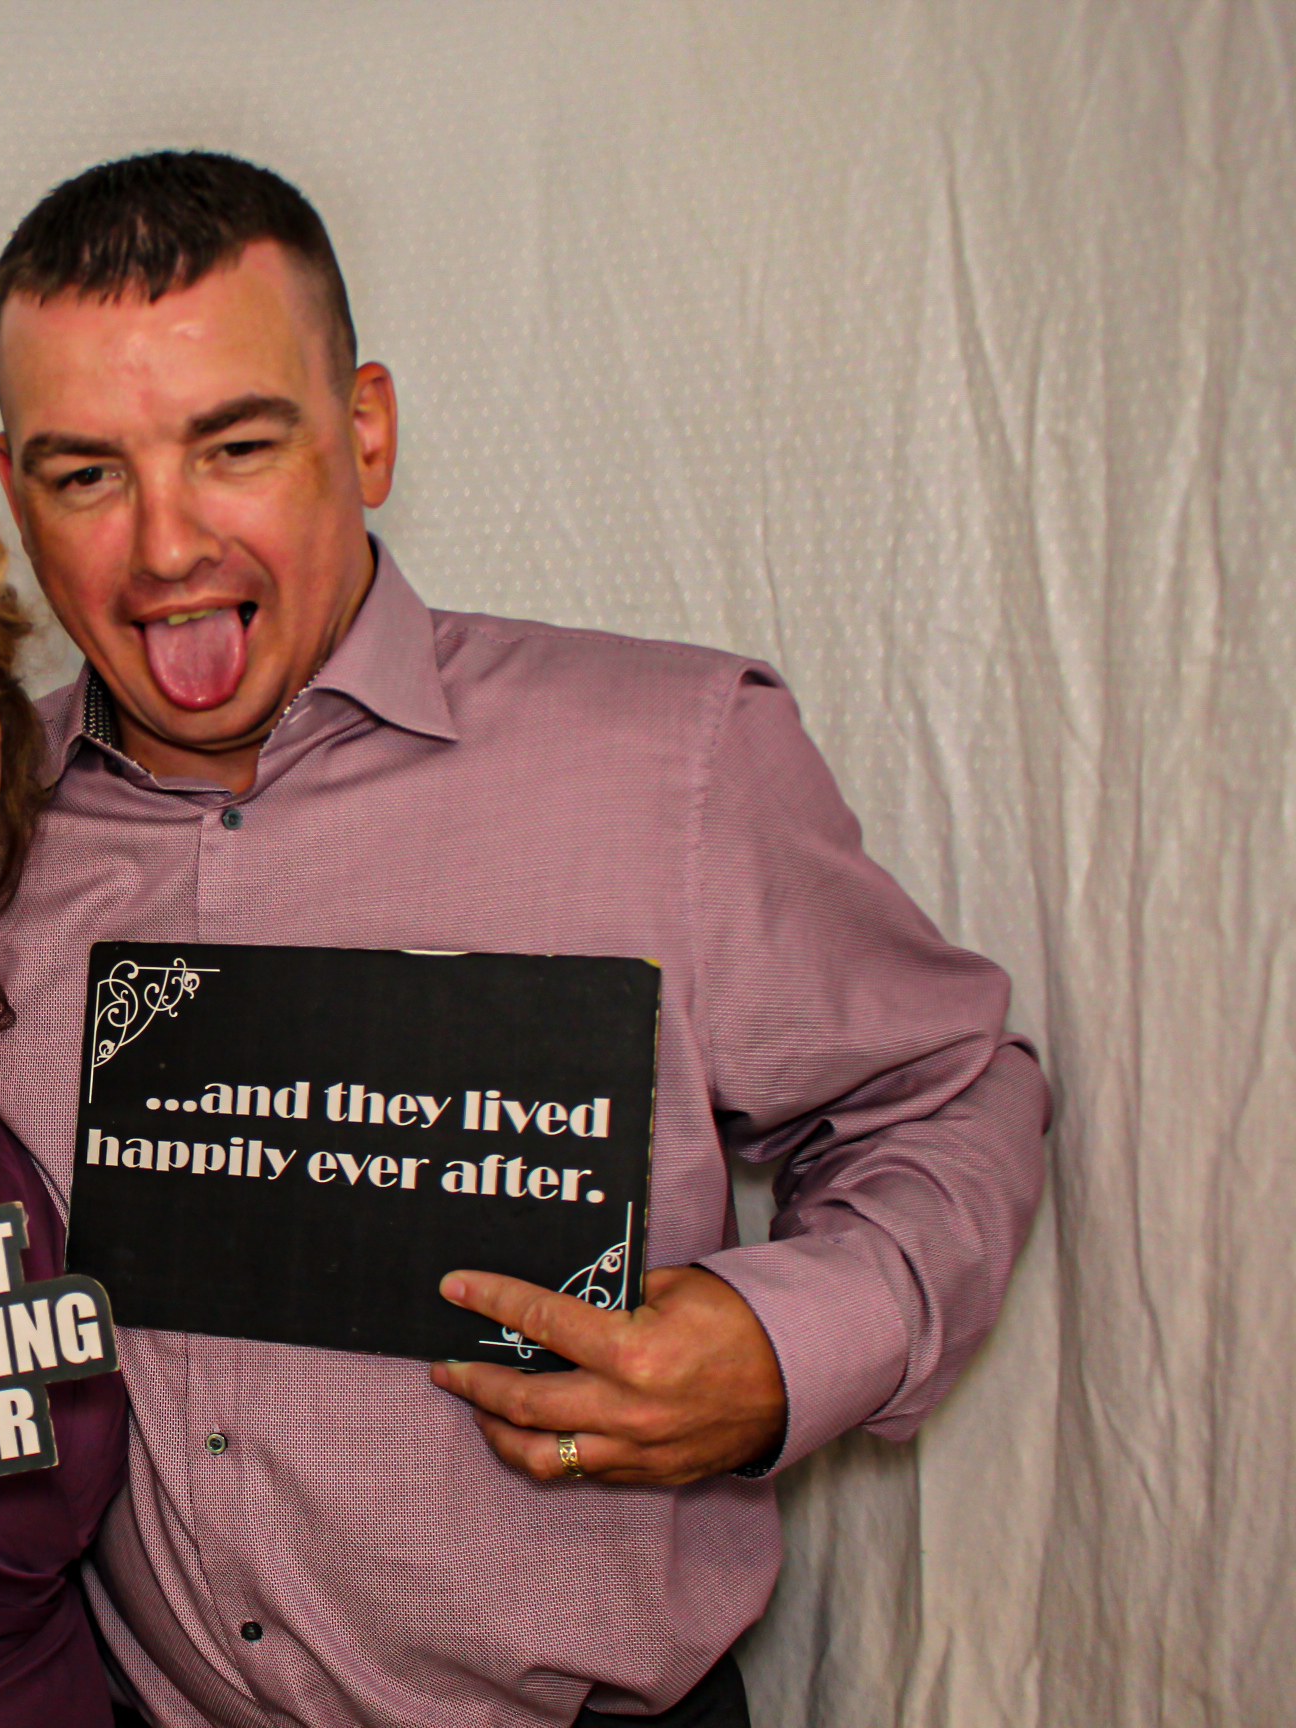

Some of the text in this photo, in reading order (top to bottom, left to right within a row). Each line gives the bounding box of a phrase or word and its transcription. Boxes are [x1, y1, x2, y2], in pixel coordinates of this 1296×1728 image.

[146, 1081, 611, 1138] ...and they lived
[86, 1128, 605, 1204] happily ever after.
